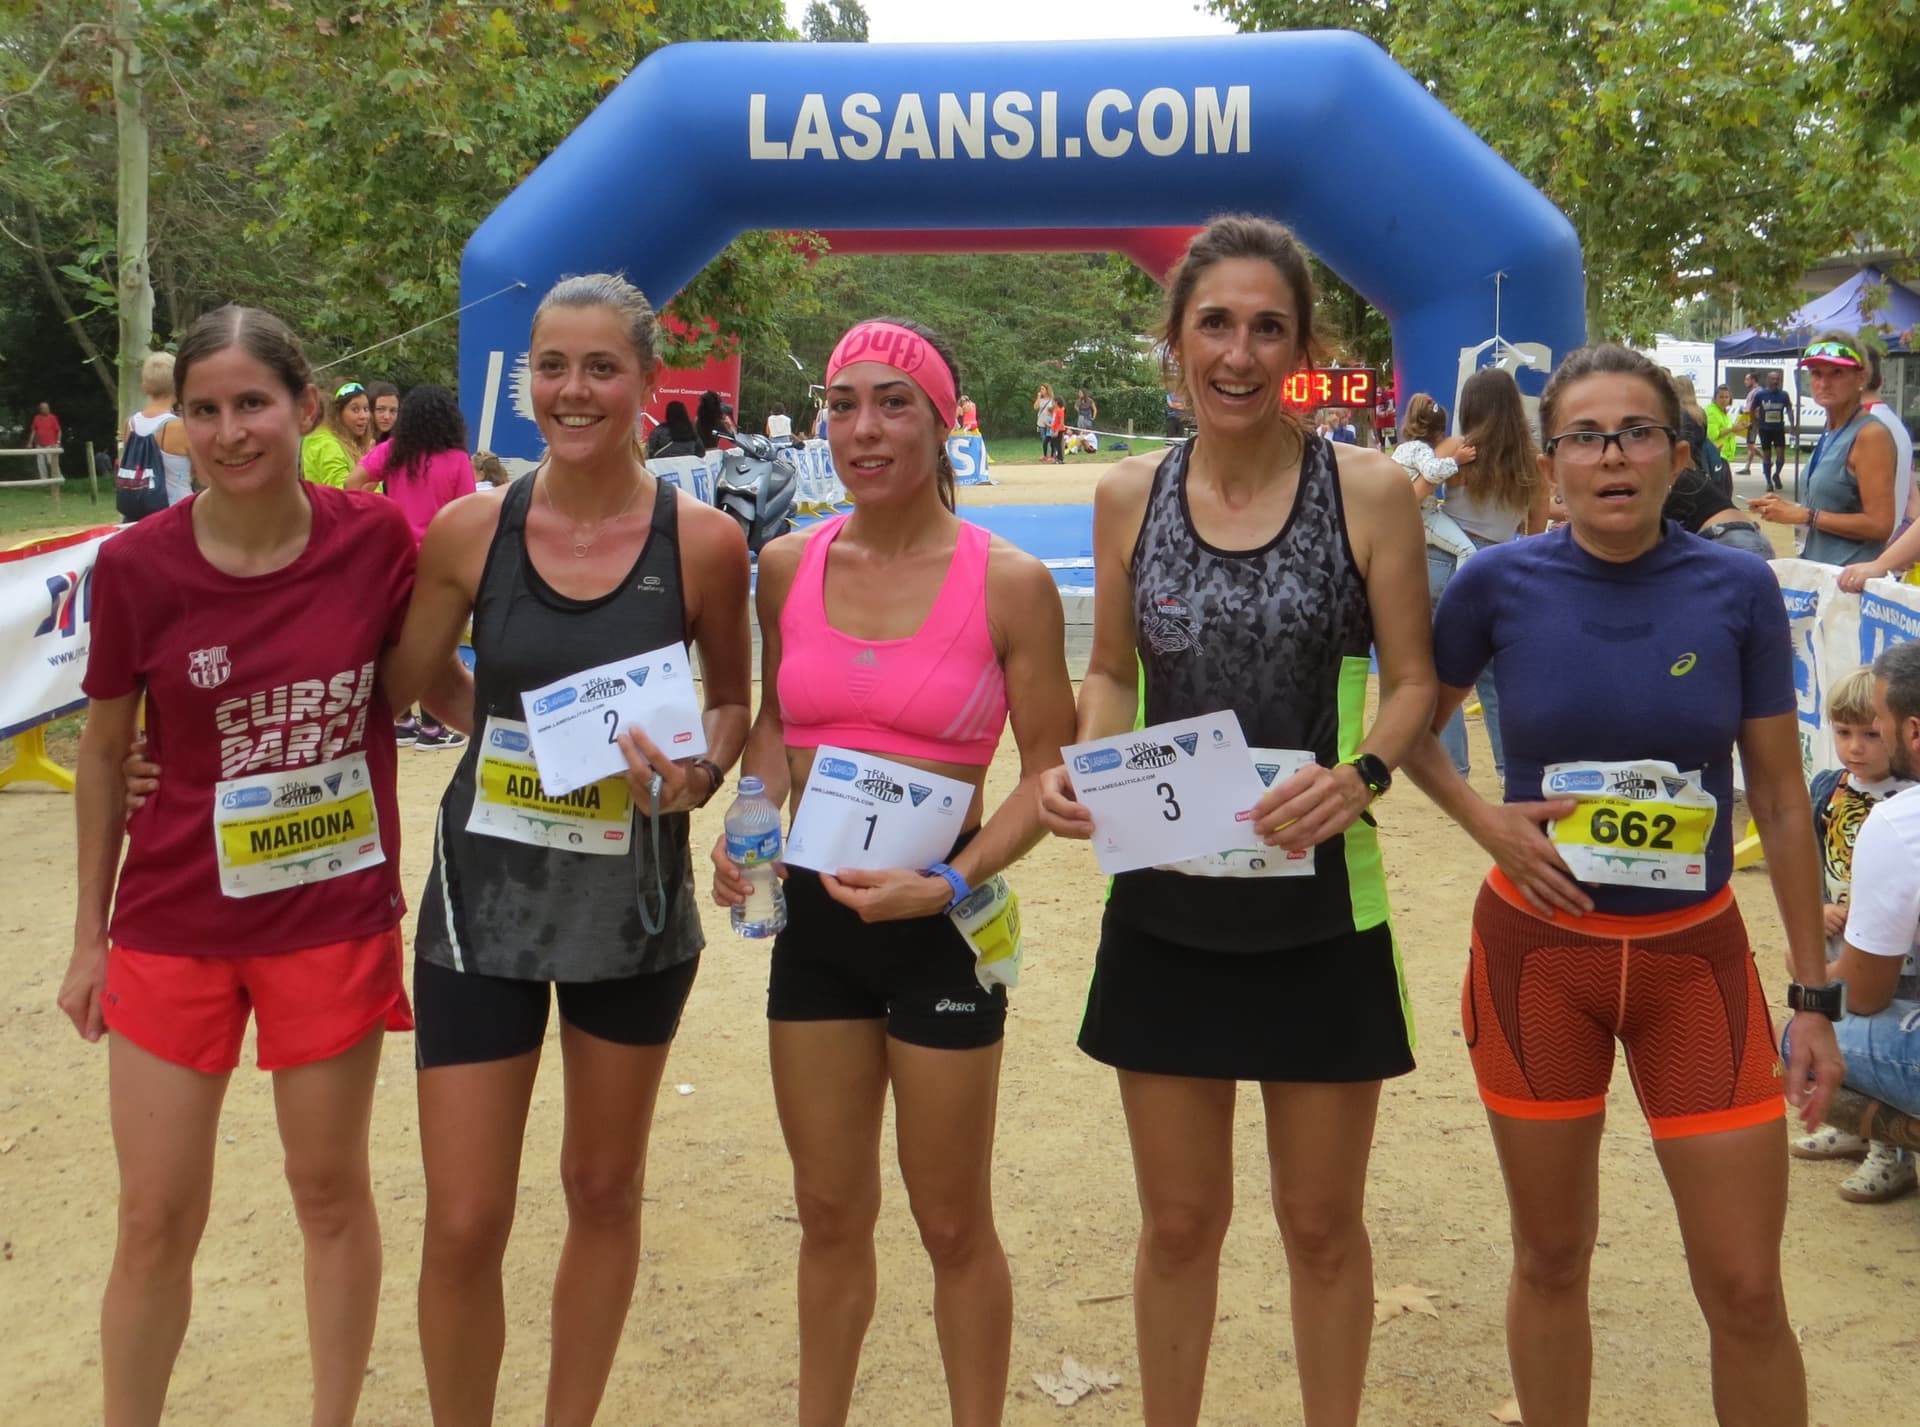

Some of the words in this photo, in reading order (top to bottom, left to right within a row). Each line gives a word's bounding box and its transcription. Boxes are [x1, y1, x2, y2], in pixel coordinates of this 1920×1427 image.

[749, 85, 1251, 160] LASANSI.COM
[1683, 355, 1702, 363] SVA
[215, 660, 375, 735] CURSA
[604, 709, 620, 744] 2
[1082, 774, 1156, 794] WWW.LAMEGALITICA.COM
[1156, 782, 1181, 821] 3
[250, 809, 355, 854] MARIONA
[864, 814, 879, 851] 1
[1590, 808, 1677, 850] 662
